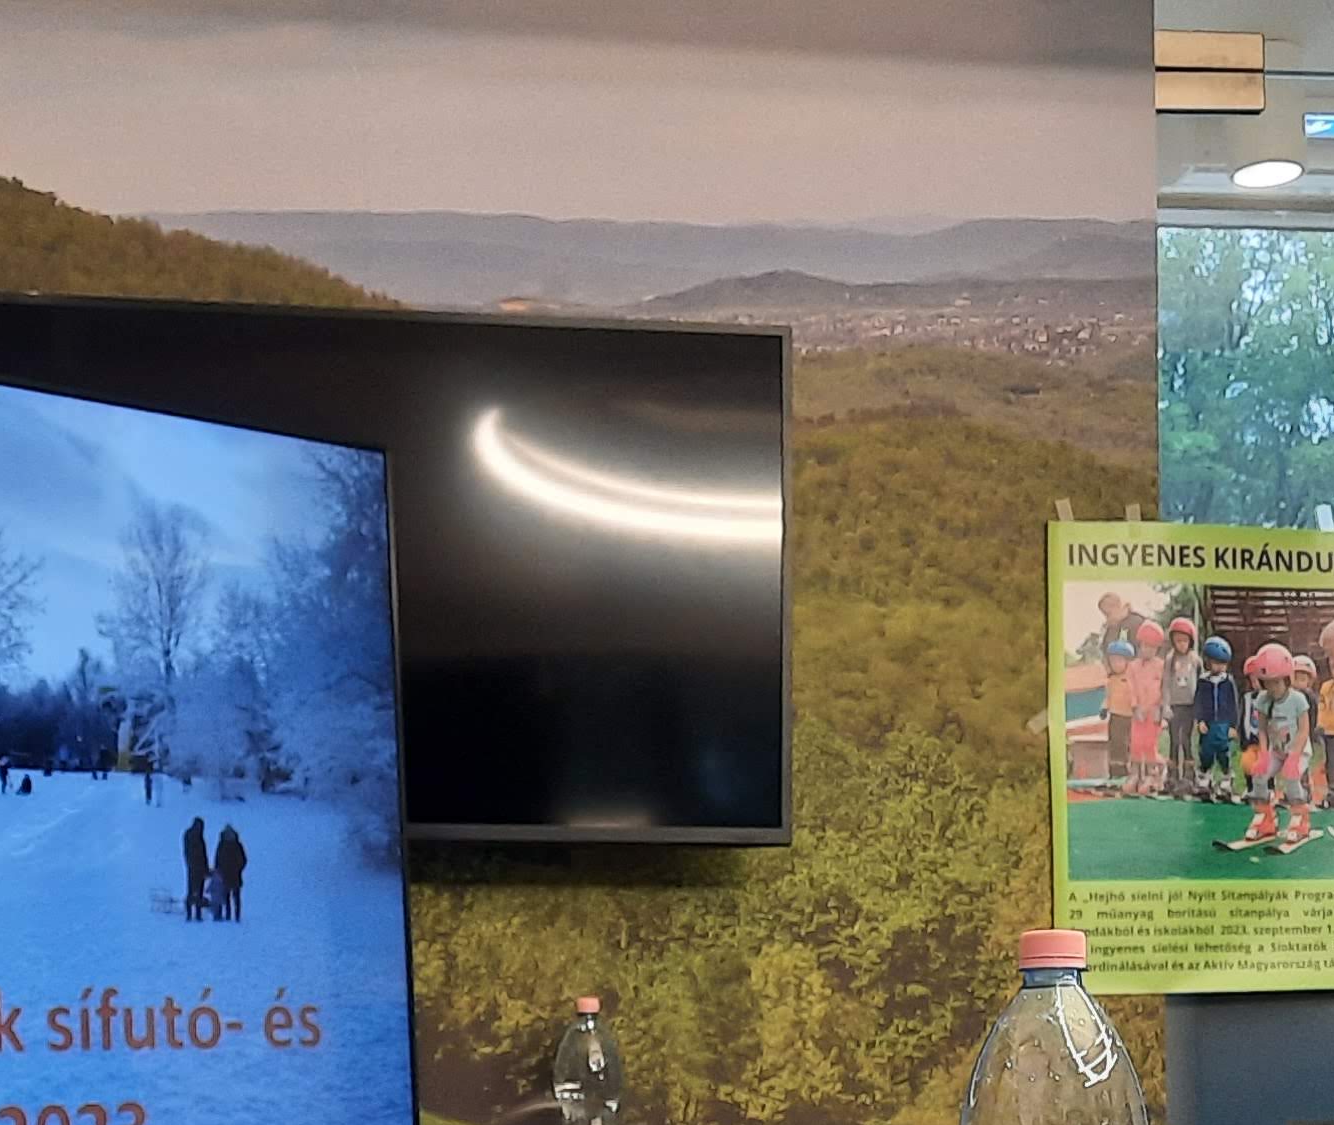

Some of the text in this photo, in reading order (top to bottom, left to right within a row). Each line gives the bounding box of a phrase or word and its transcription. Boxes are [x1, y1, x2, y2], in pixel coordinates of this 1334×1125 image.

[1068, 543, 1206, 568] INGYENES
[1068, 893, 1077, 902] A
[1303, 906, 1333, 920] várja
[1137, 925, 1150, 936] és
[1254, 924, 1322, 938] szeptember
[1090, 942, 1145, 956] ingyenes
[1258, 944, 1265, 952] a
[1172, 959, 1184, 970] és
[1188, 961, 1199, 971] az
[1237, 957, 1321, 972] Magyarország
[46, 986, 243, 1052] sífutó-
[265, 986, 323, 1050] és
